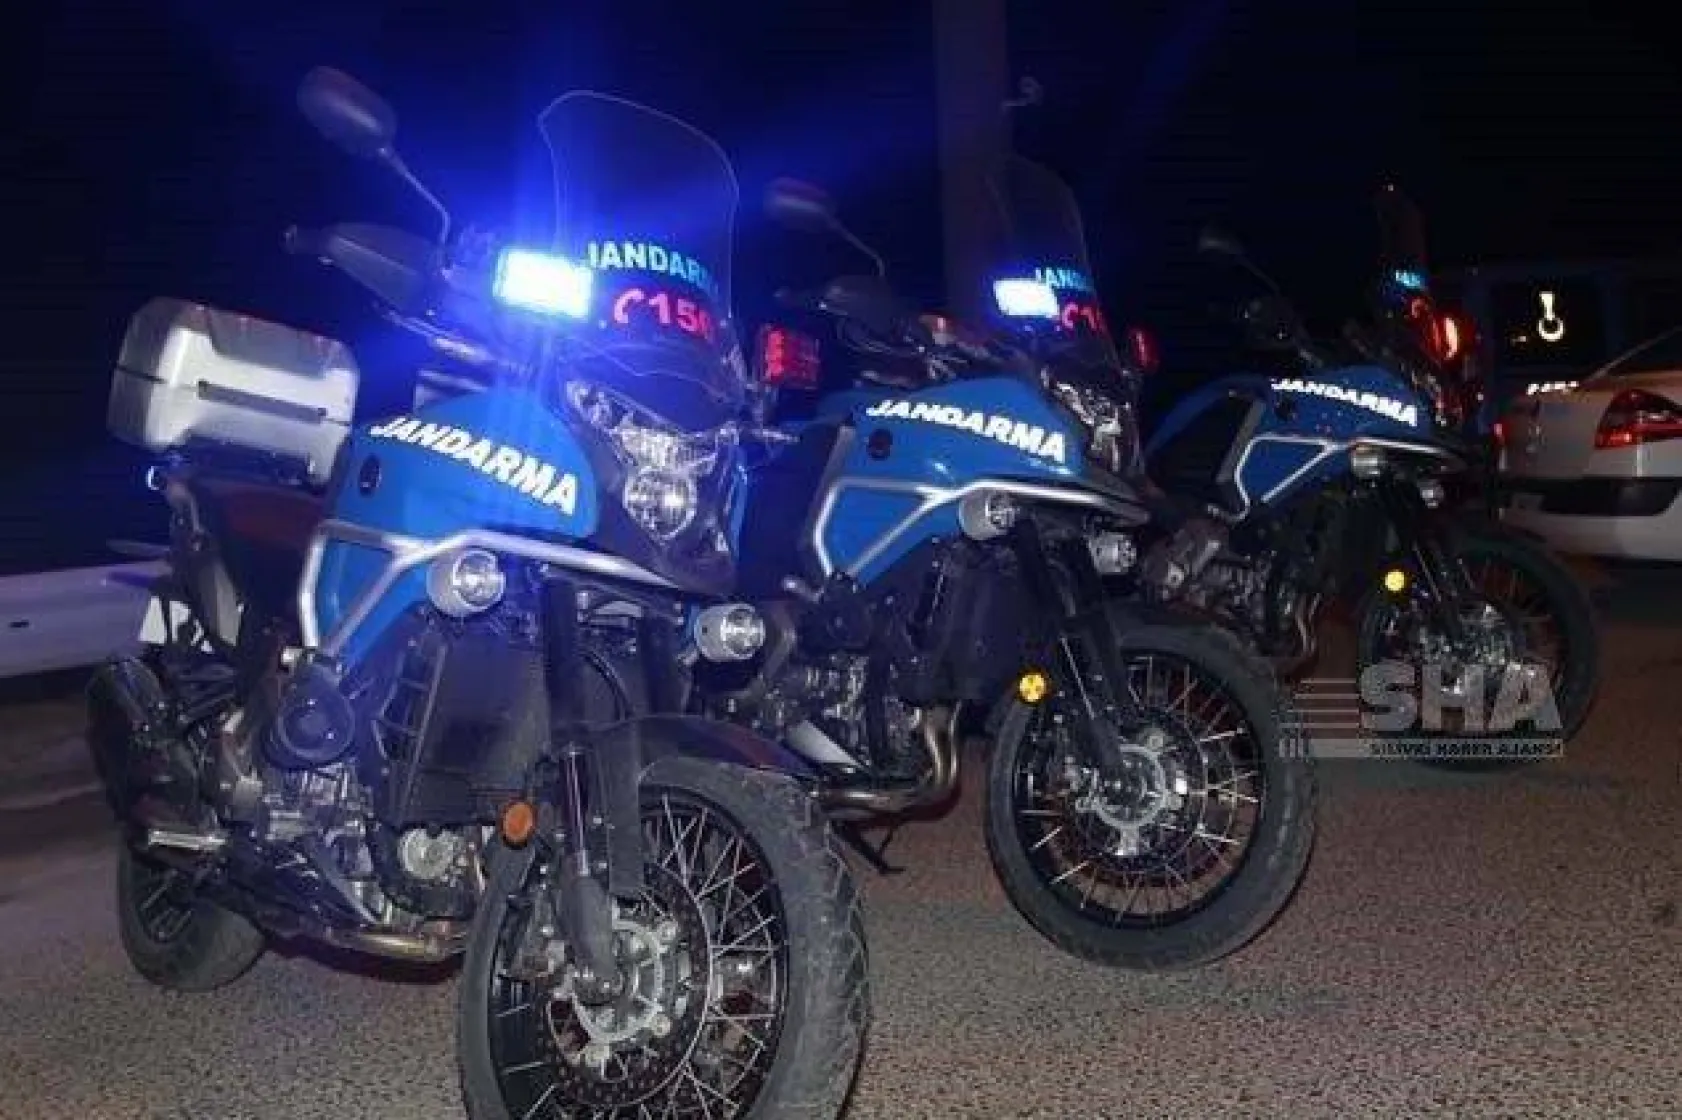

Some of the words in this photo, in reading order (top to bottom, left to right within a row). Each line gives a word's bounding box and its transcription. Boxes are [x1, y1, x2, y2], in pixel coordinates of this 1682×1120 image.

[866, 399, 1065, 463] JANDARMA
[1270, 378, 1418, 427] JANDARMA
[370, 417, 576, 516] JANDARMA
